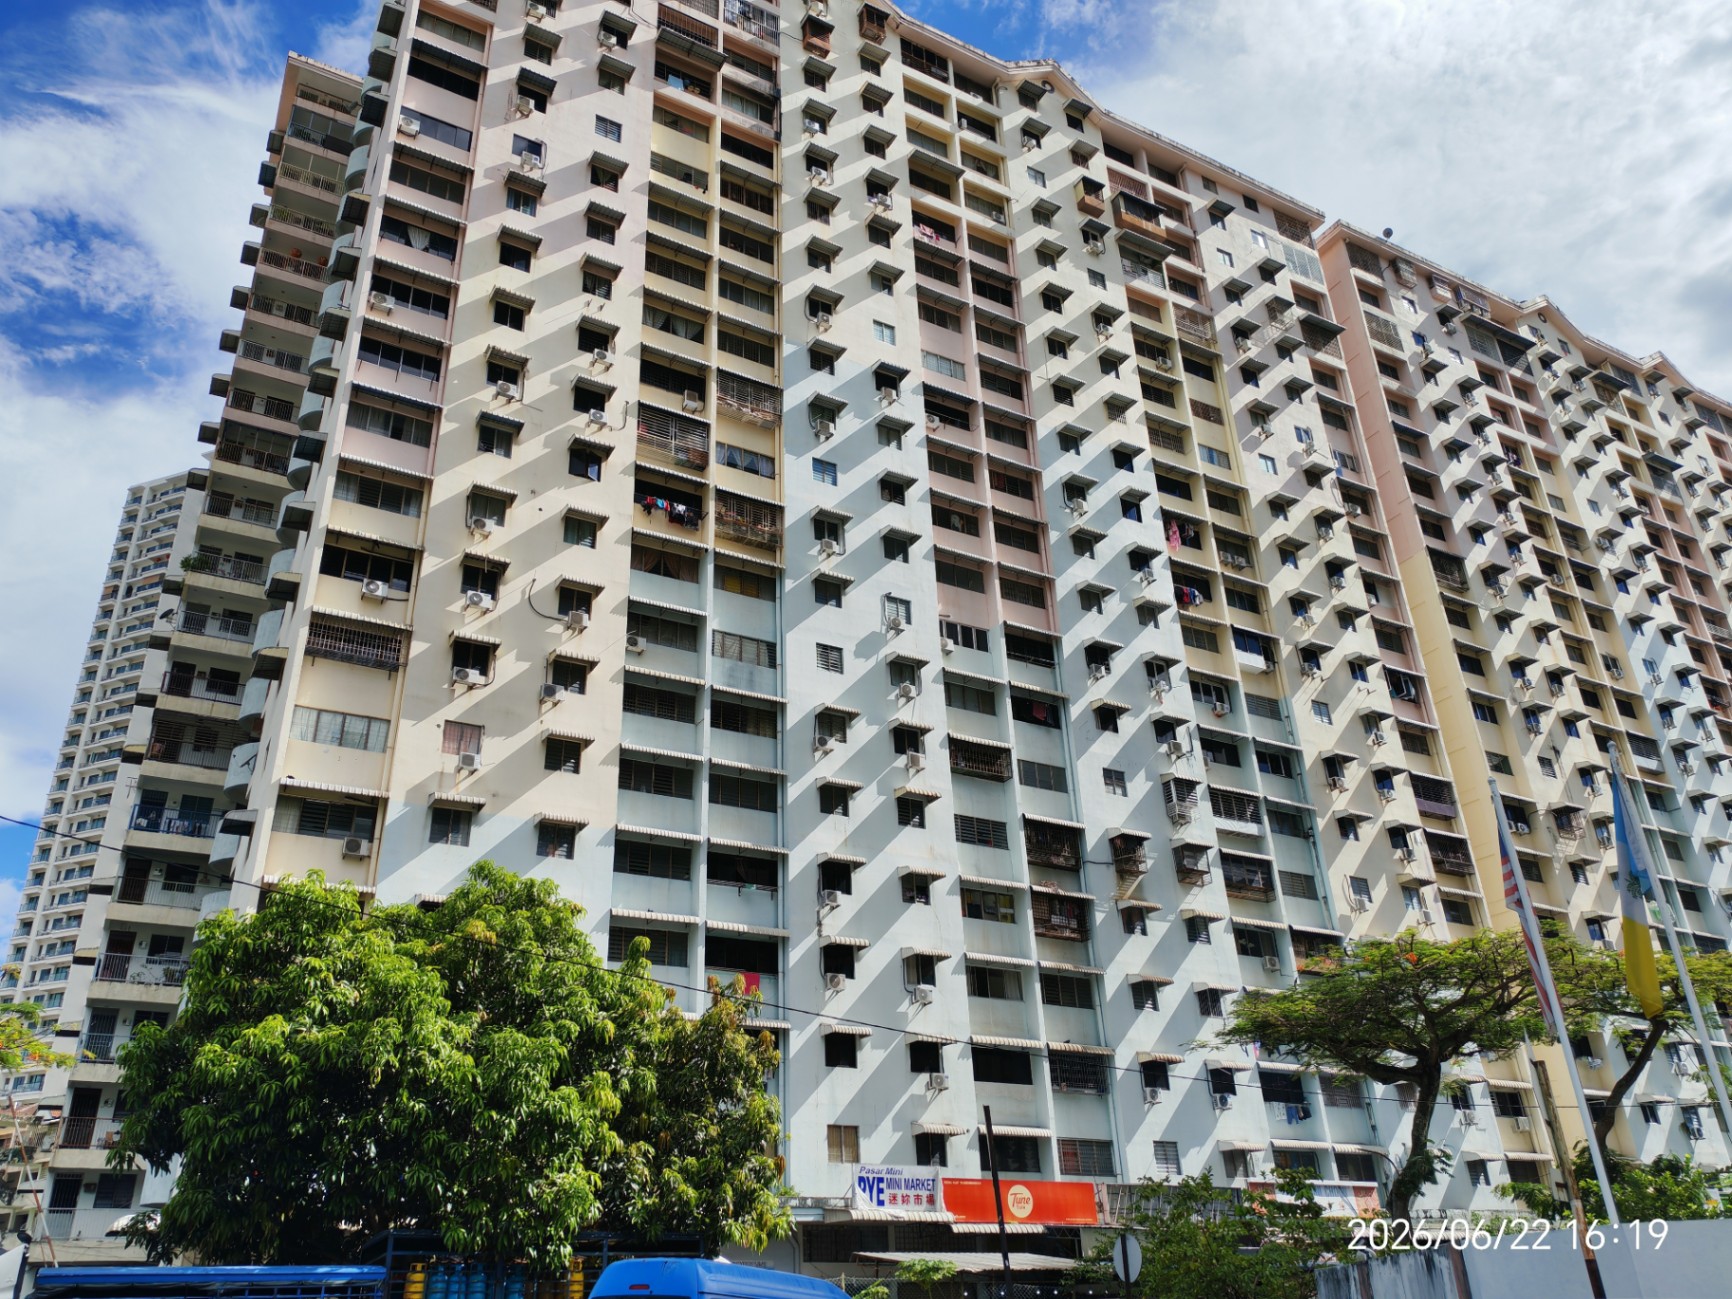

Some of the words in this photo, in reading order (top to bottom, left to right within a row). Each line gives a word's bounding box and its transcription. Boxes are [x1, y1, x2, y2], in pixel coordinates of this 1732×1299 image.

[859, 1166, 885, 1175] Pasar
[885, 1167, 903, 1175] Mini
[886, 1177, 902, 1190] MINI
[904, 1178, 936, 1192] MARKET
[1010, 1193, 1031, 1208] Tune
